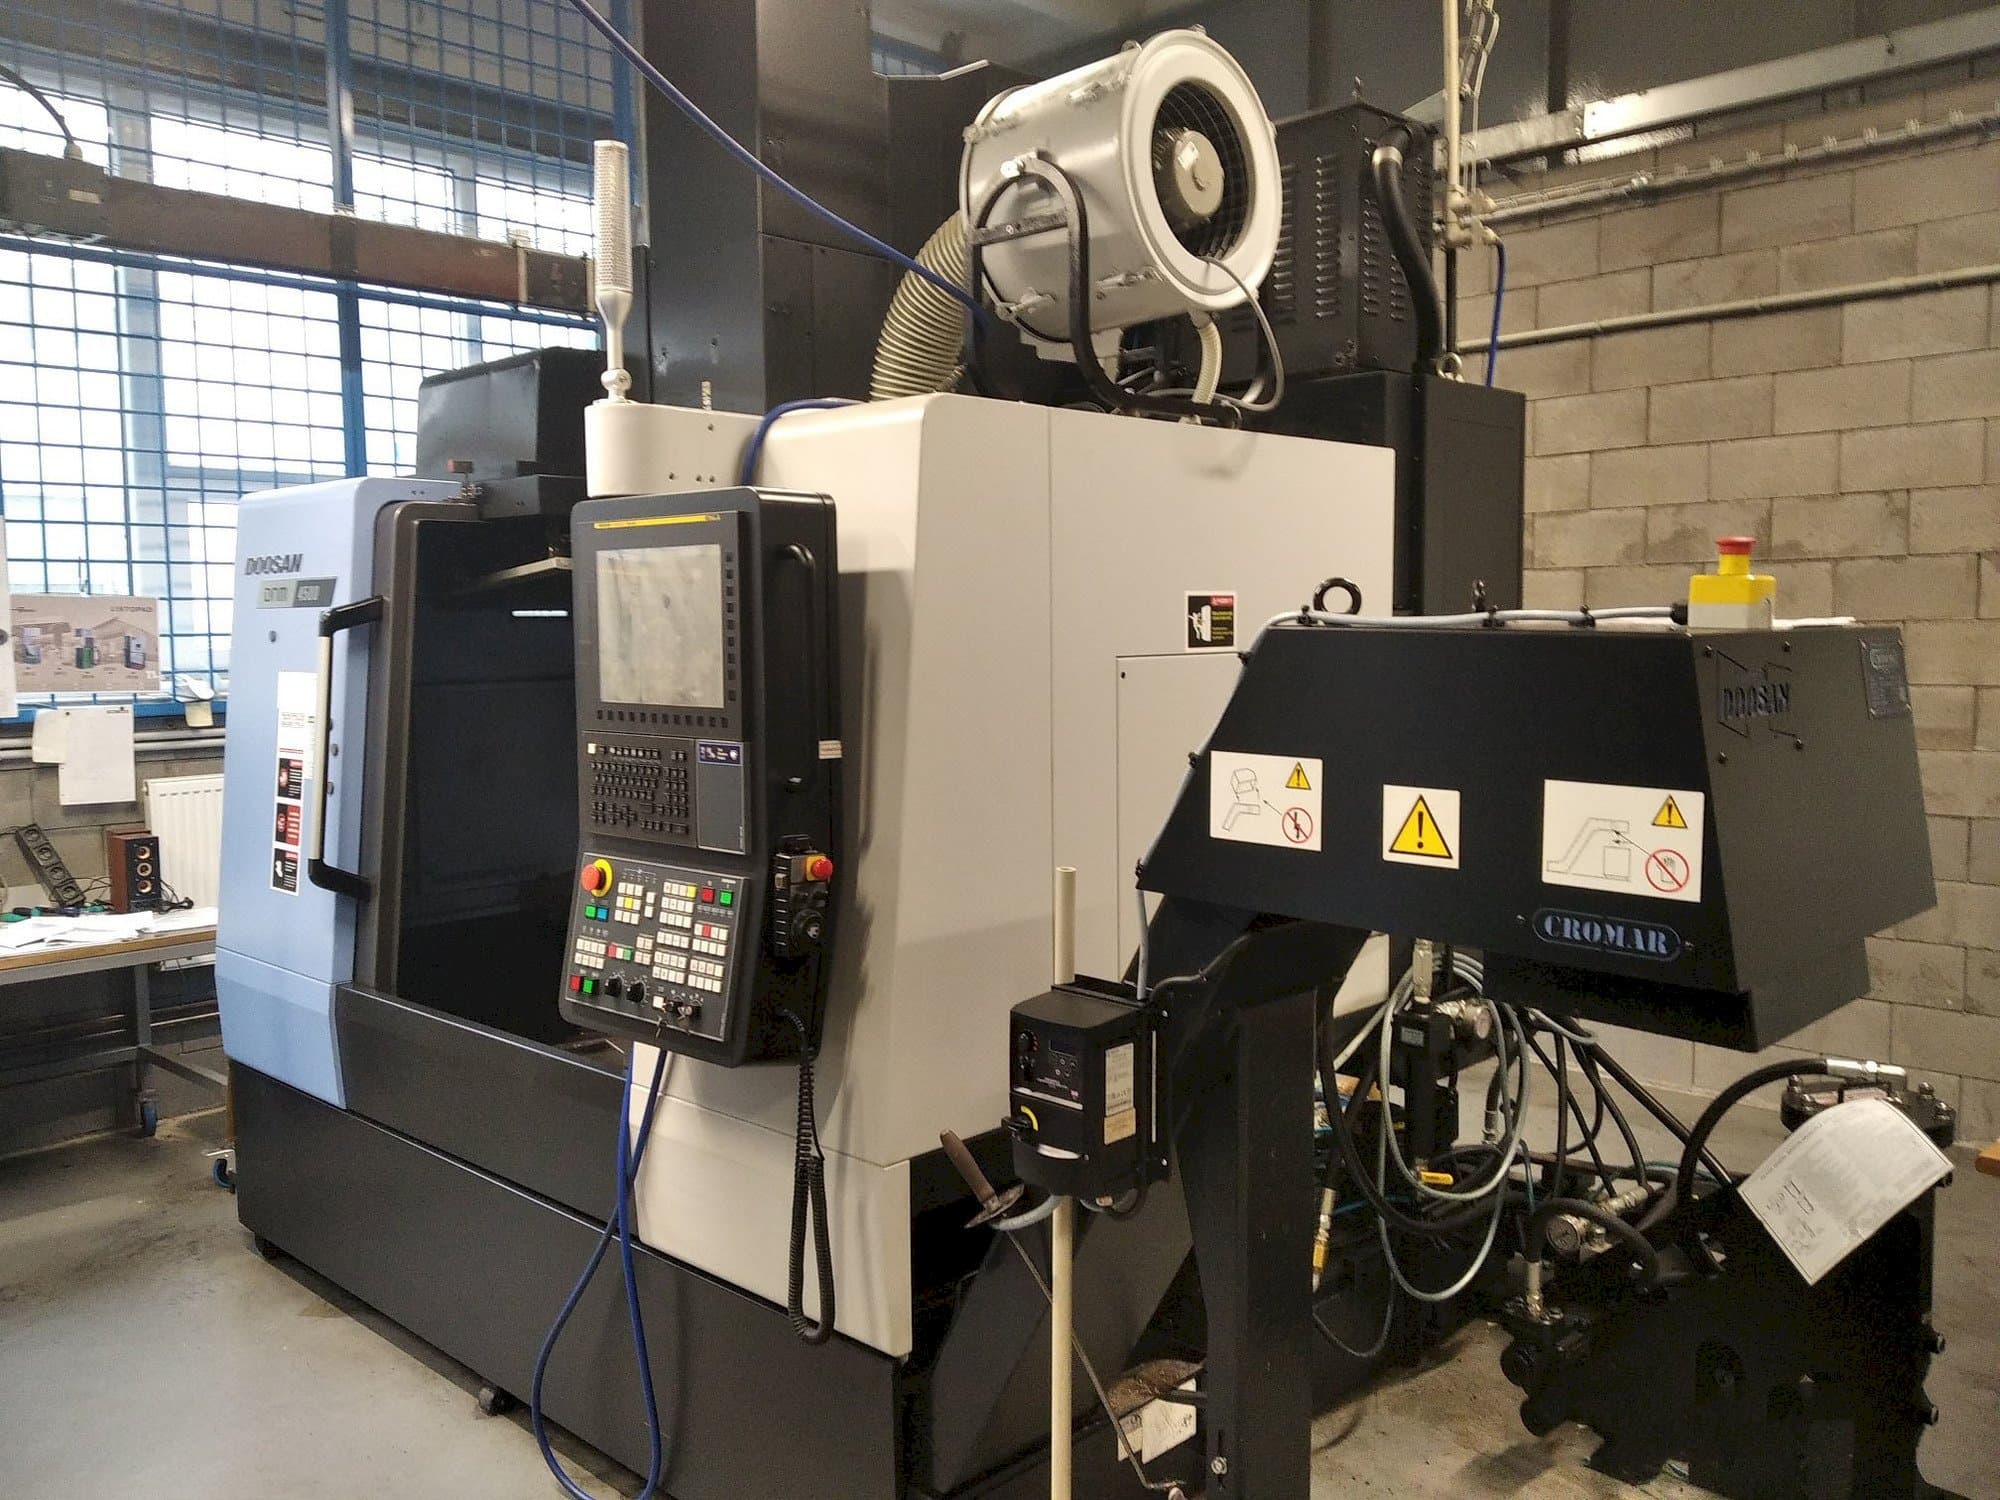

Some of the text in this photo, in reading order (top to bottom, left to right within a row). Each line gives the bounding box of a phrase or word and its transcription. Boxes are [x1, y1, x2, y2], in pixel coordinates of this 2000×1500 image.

[245, 553, 303, 576] DOOSAN
[1720, 683, 1789, 720] DOOSAN
[1544, 914, 1668, 955] CROMAR
